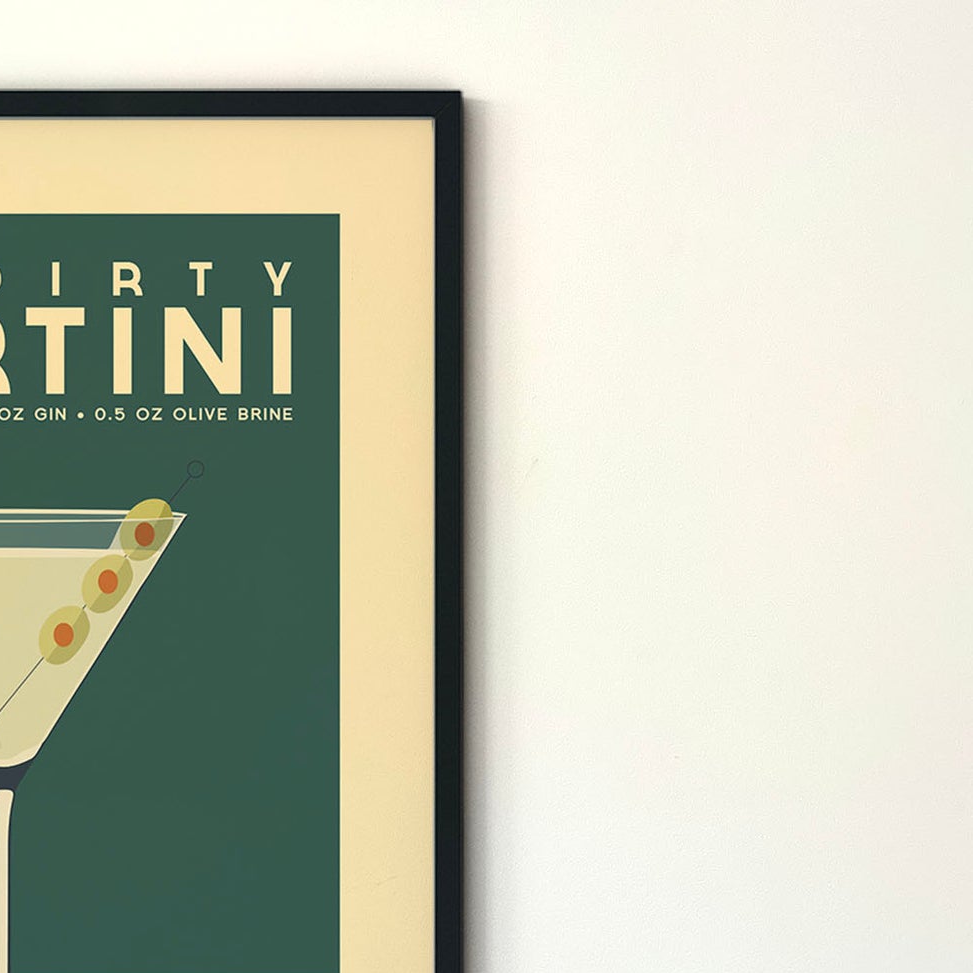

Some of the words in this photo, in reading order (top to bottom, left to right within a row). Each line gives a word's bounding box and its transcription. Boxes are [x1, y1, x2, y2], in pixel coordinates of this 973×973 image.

[34, 407, 67, 421] GIN
[94, 407, 126, 421] 0.5
[135, 407, 163, 421] OZ
[172, 407, 228, 421] OLIVE
[238, 407, 293, 421] BRINE
